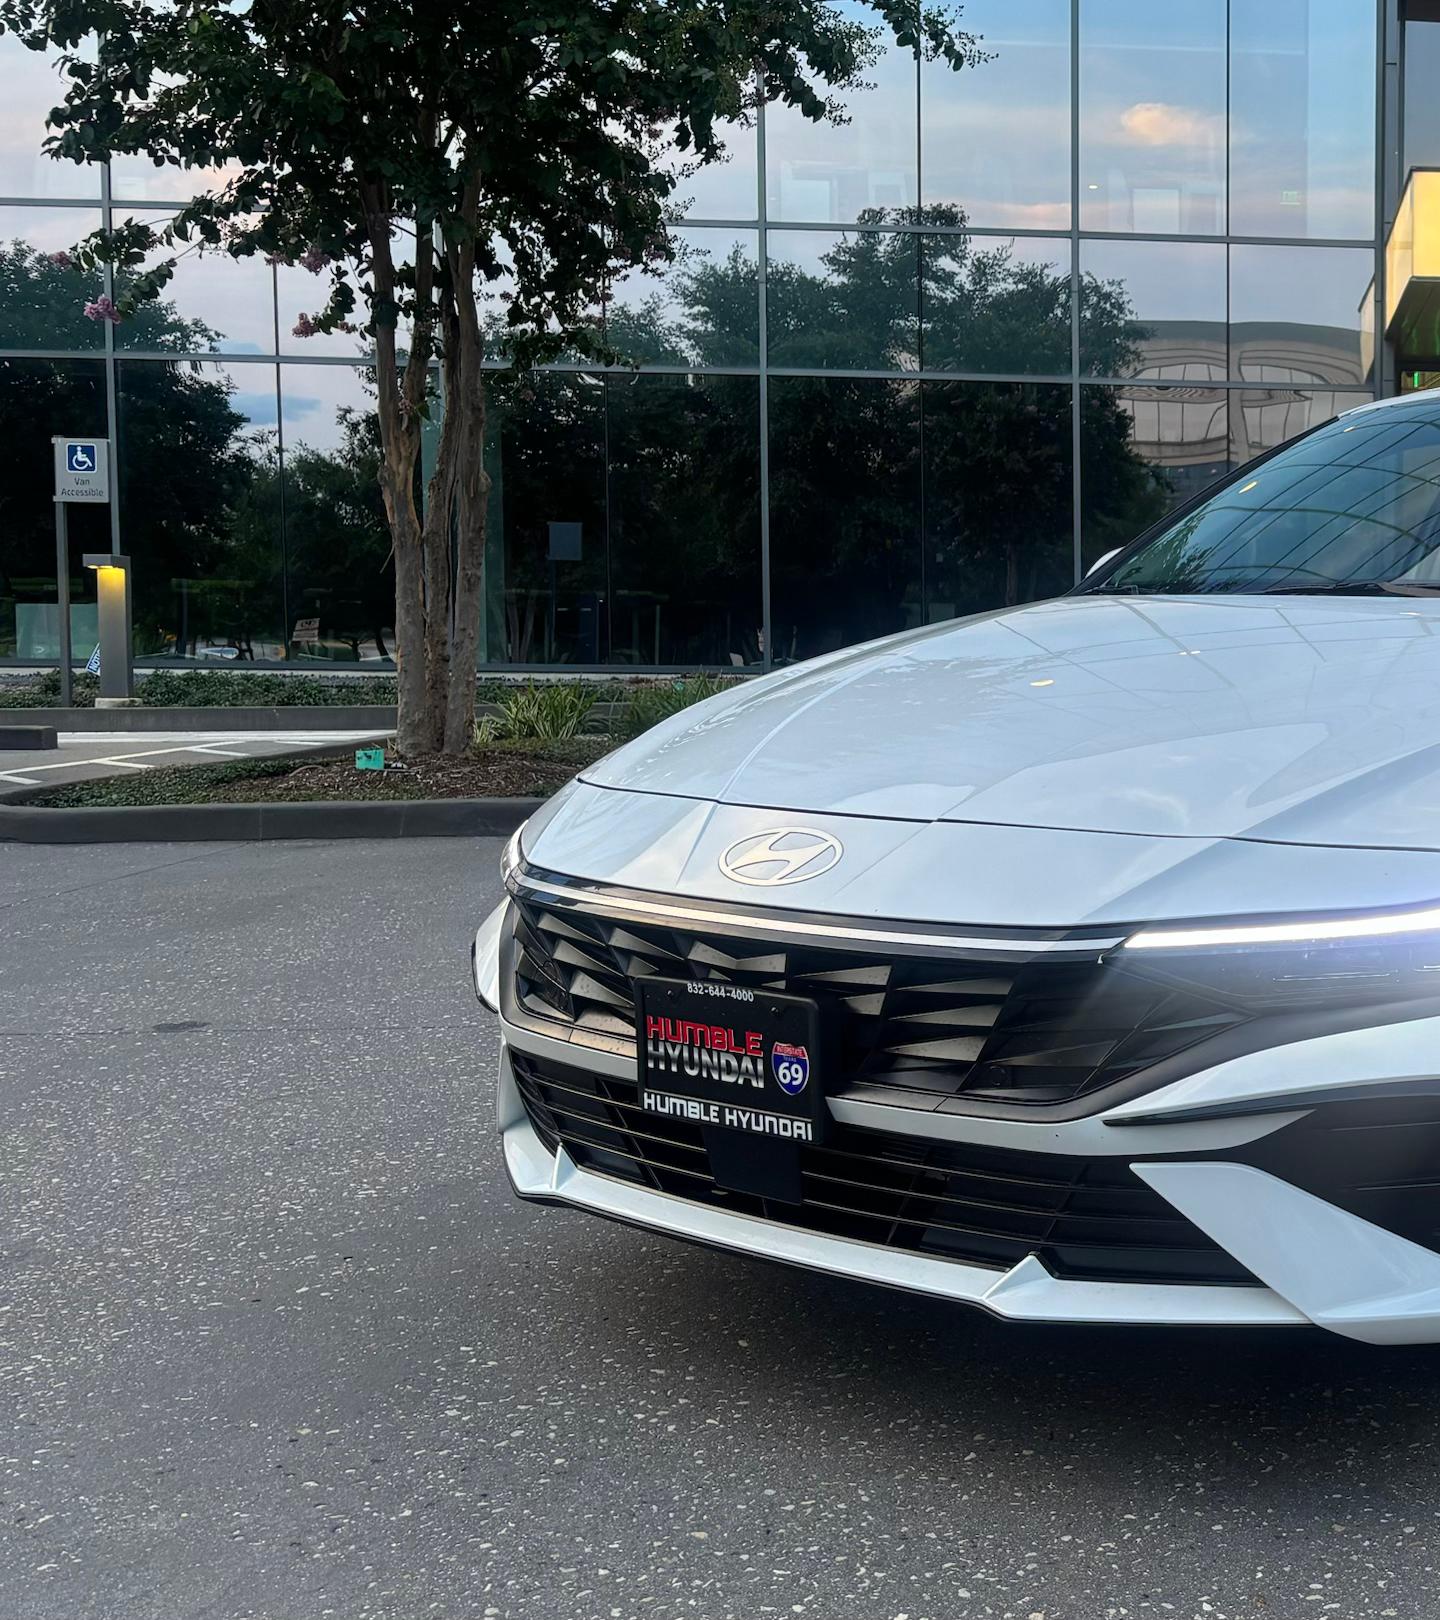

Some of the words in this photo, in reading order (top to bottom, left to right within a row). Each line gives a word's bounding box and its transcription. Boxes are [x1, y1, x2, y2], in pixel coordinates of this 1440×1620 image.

[74, 477, 90, 486] Van
[61, 488, 104, 497] Accessible
[687, 982, 754, 1002] 832-644-4000
[647, 1039, 764, 1089] HYUNDAI
[778, 1062, 803, 1086] 69
